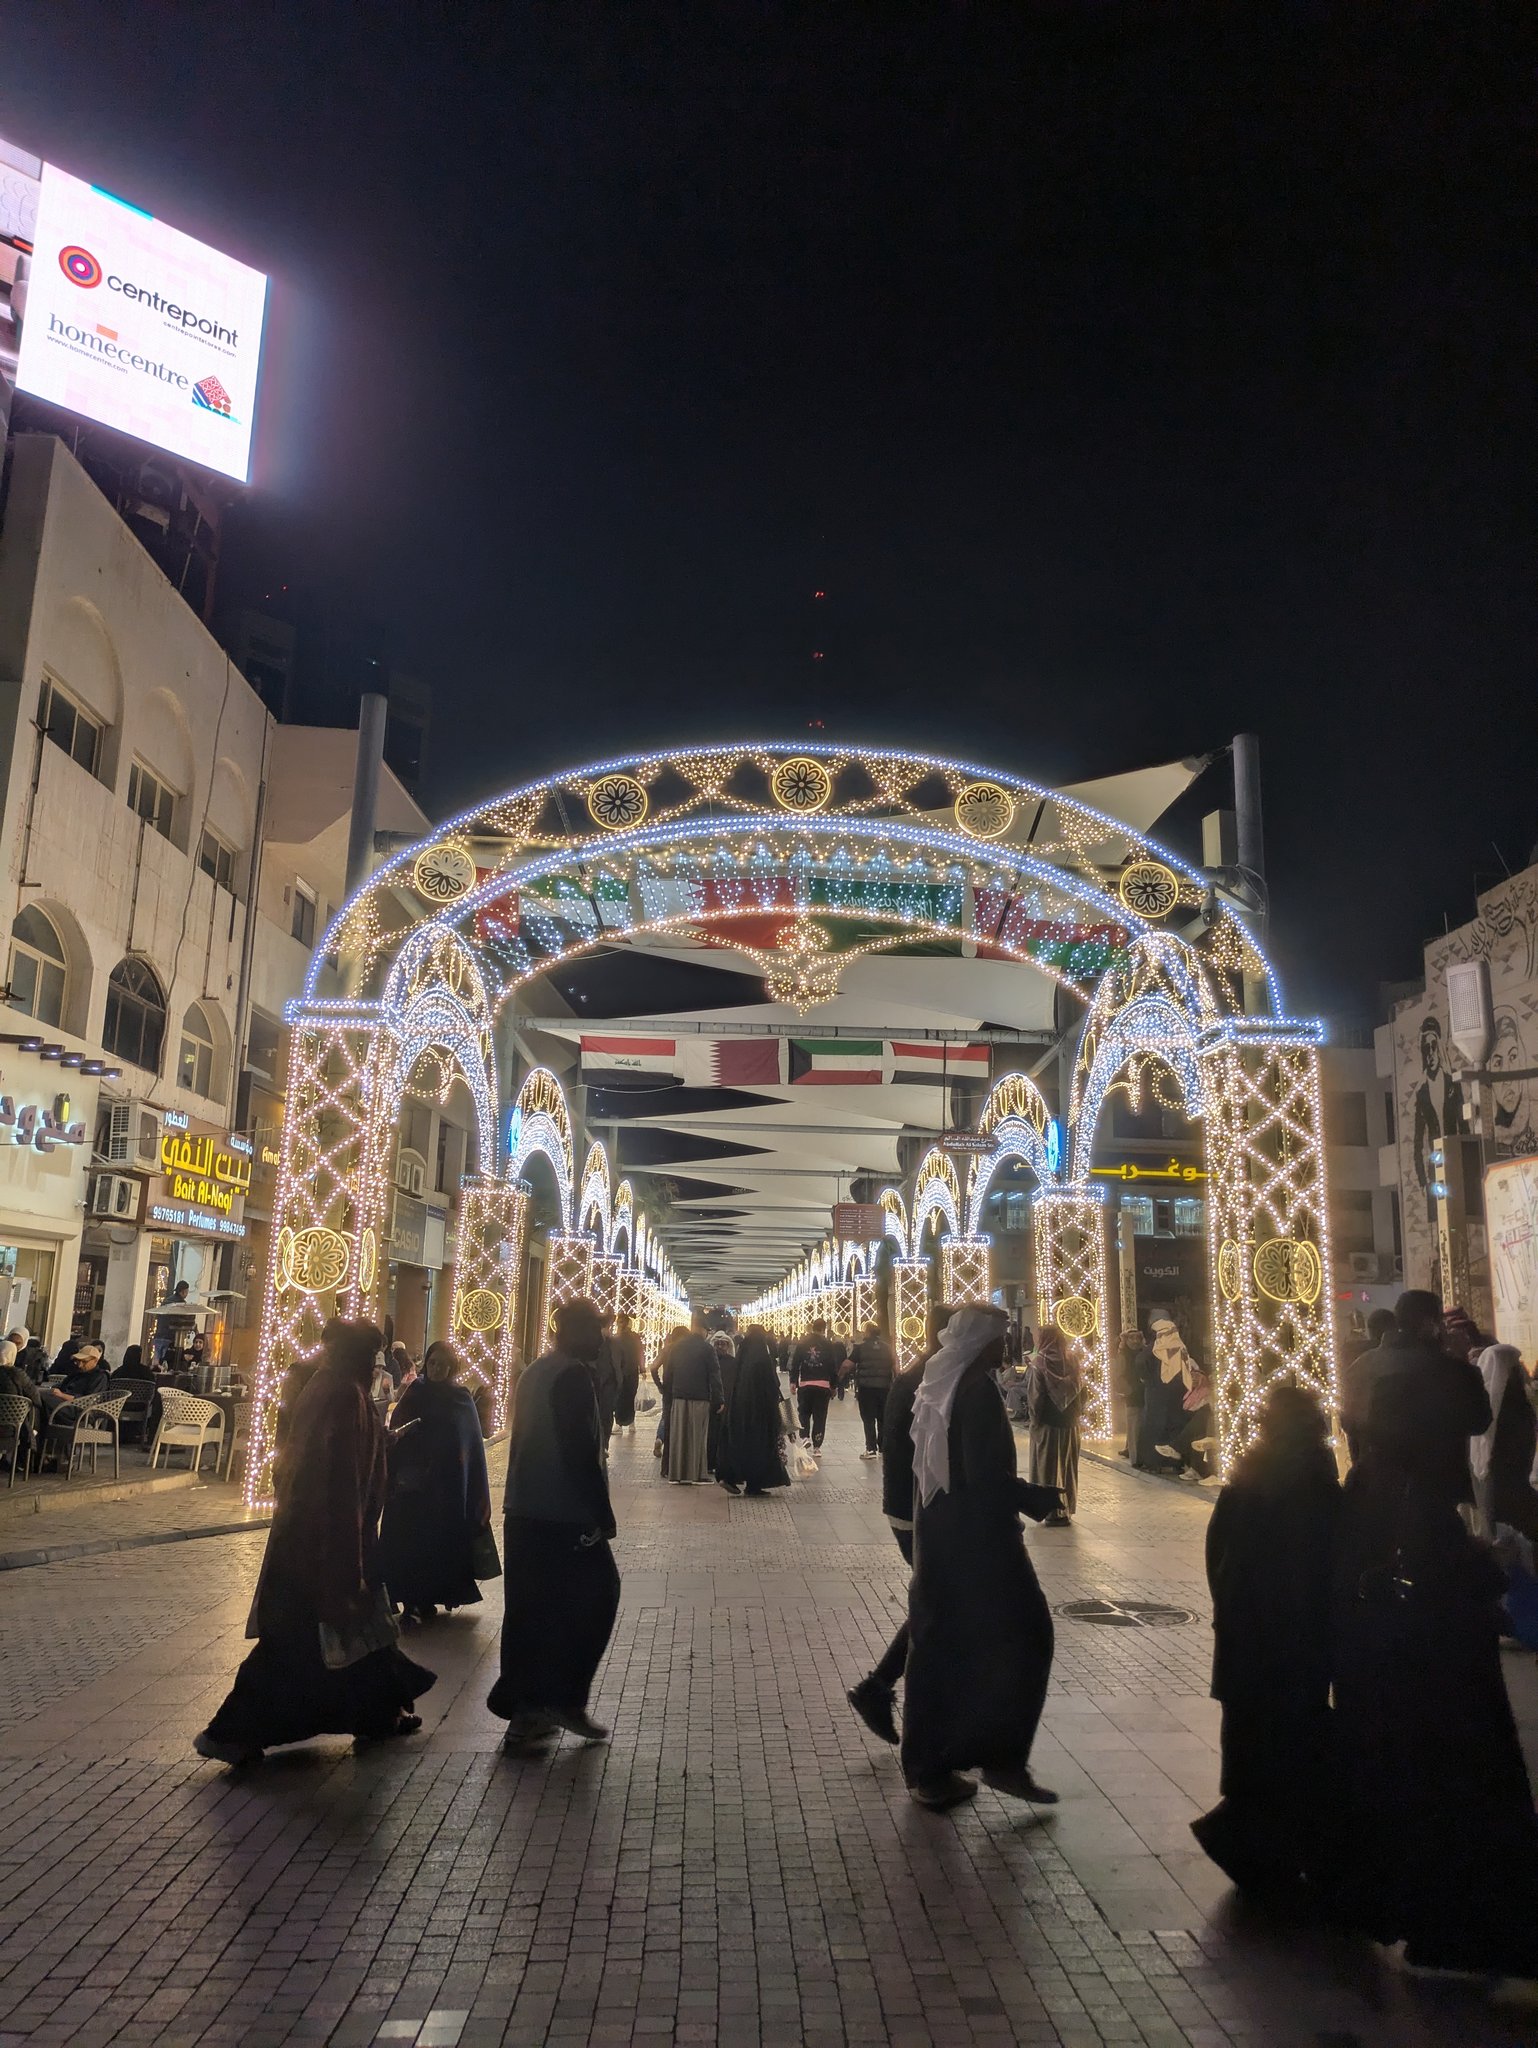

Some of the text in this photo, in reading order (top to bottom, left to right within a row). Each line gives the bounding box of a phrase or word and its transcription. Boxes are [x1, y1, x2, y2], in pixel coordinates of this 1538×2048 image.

[107, 275, 239, 348] centrepoint
[46, 335, 128, 374] www.homecentre.com
[165, 1111, 189, 1129] للعطور
[161, 1131, 252, 1197] بيت النقي
[173, 1174, 234, 1216] Bait Al-Naqi
[152, 1206, 186, 1225] 99765181
[188, 1209, 217, 1230] Perfumes
[1143, 1265, 1180, 1279] الكويت
